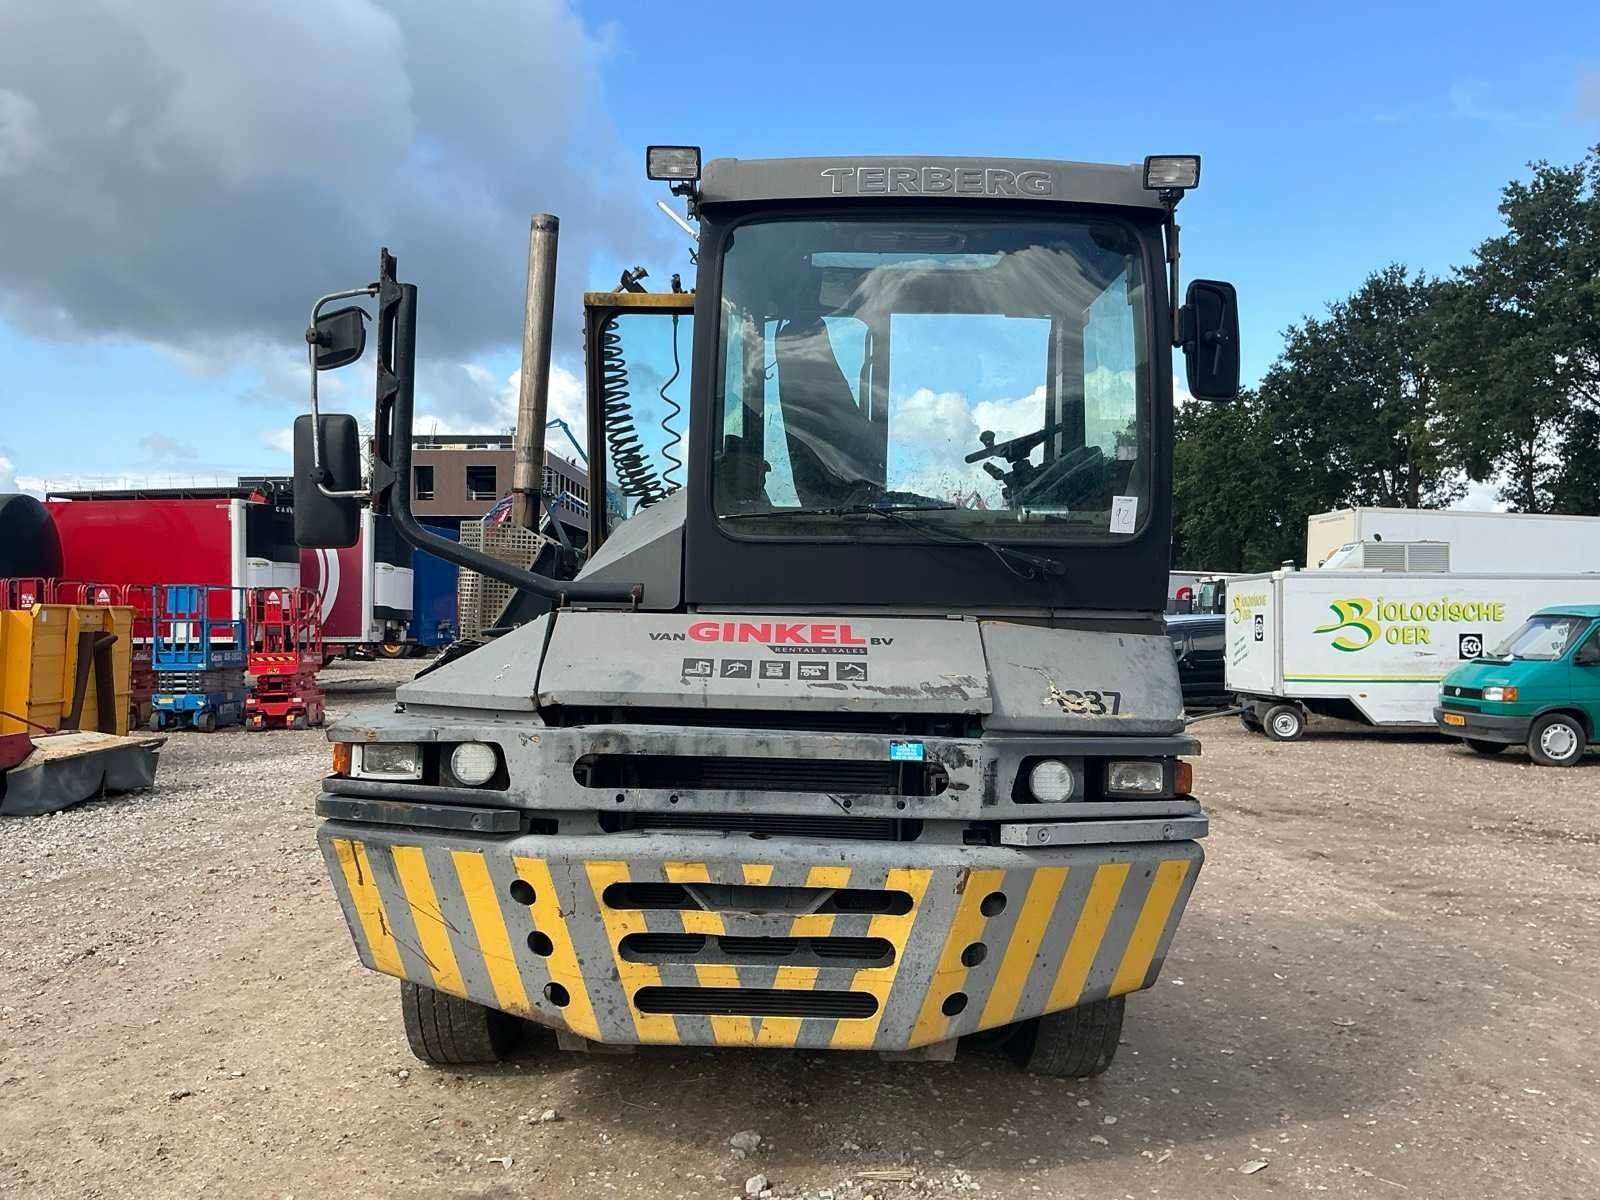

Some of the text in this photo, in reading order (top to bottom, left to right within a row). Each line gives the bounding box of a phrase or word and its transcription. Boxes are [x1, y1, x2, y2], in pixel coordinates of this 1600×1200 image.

[820, 167, 1054, 195] TERBERG
[648, 622, 895, 646] VAN GINKEL BV
[775, 646, 817, 654] RENTAL
[831, 647, 865, 655] SALES
